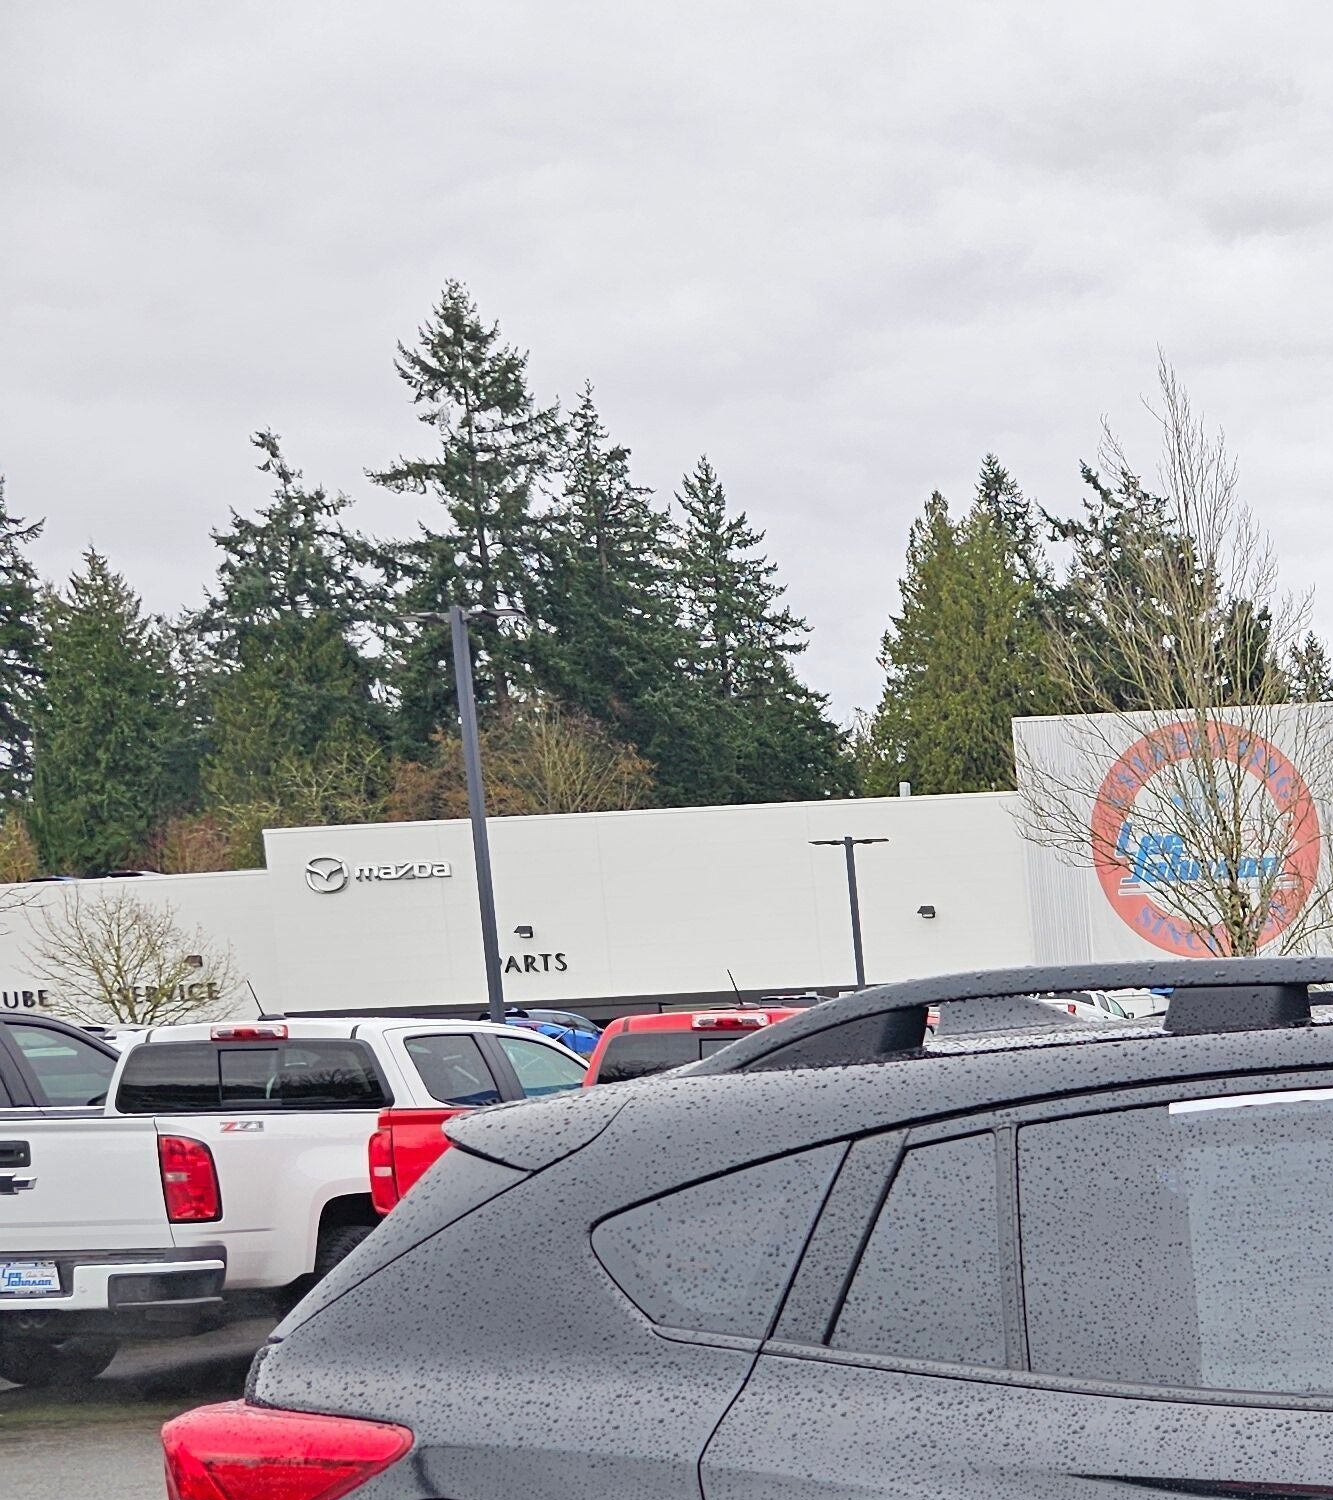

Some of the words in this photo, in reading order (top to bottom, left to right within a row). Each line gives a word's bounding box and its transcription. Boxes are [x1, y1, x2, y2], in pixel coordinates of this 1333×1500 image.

[354, 861, 452, 881] mazda
[499, 953, 568, 974] ARTS
[0, 989, 49, 1009] UBE
